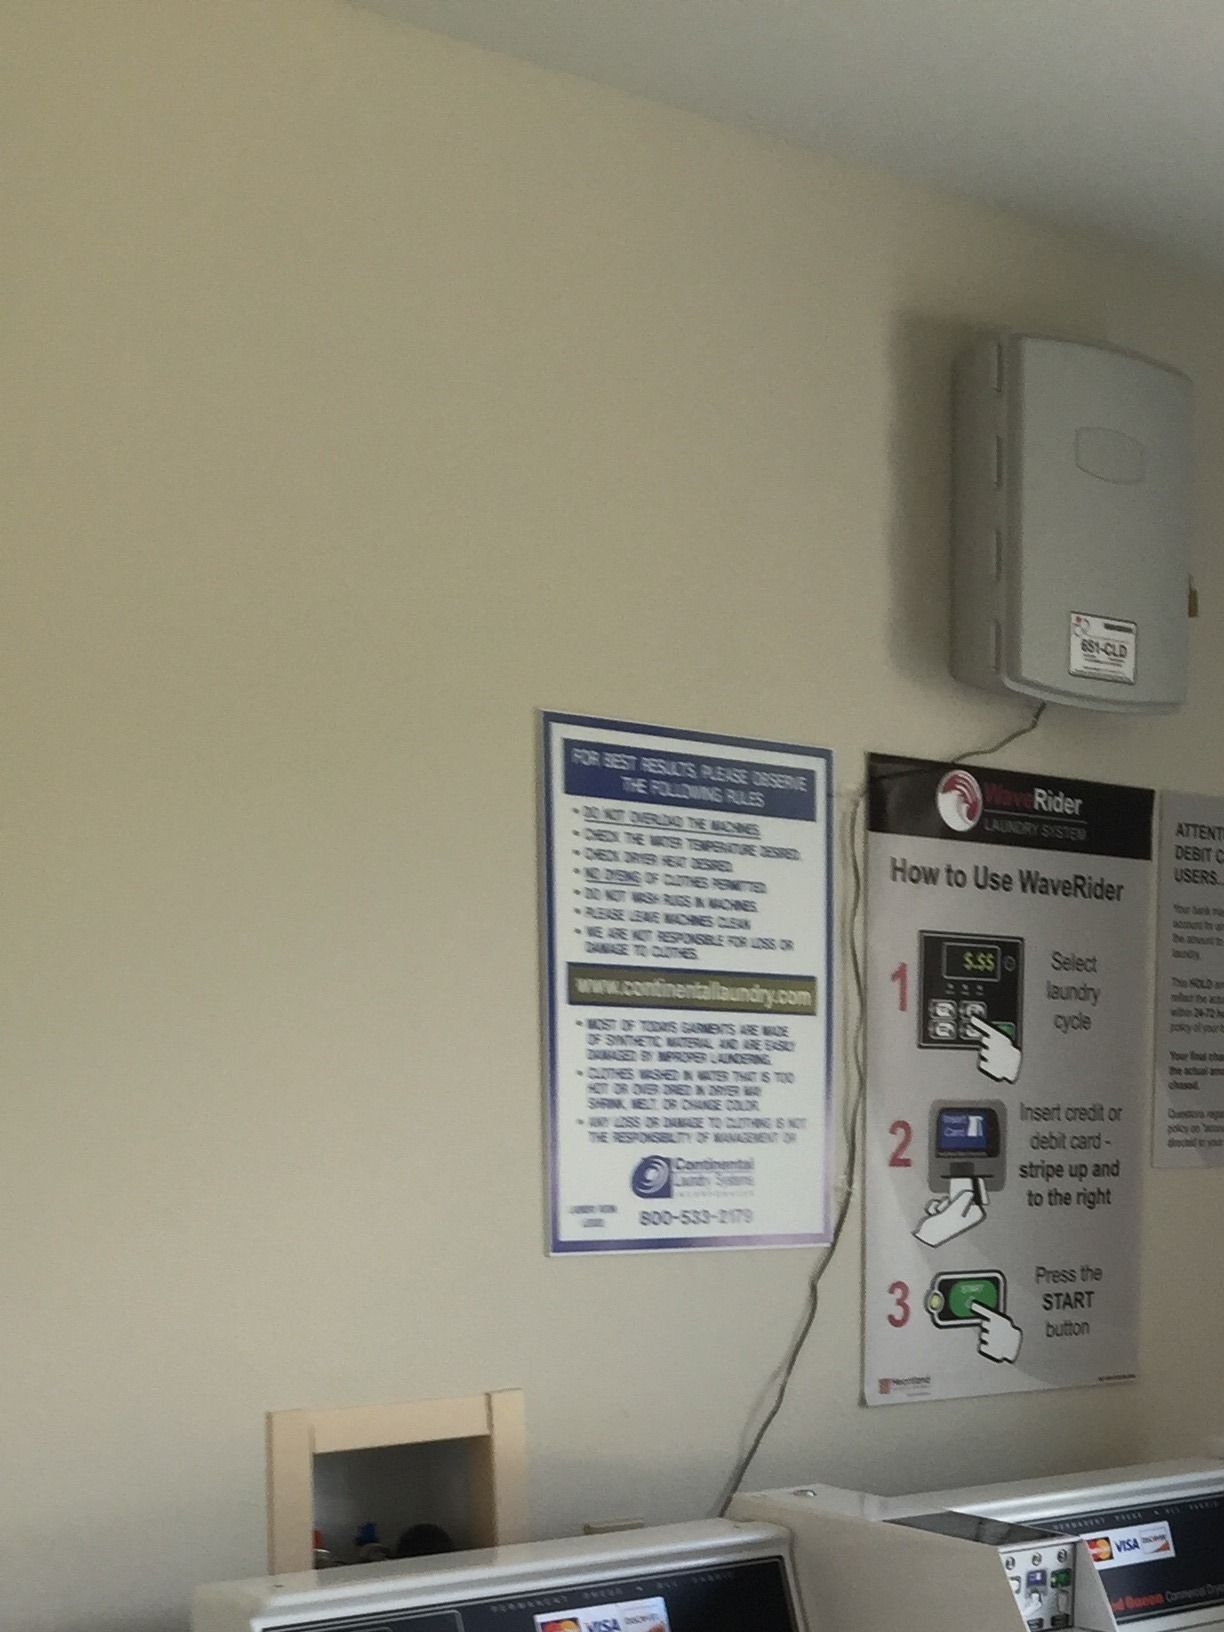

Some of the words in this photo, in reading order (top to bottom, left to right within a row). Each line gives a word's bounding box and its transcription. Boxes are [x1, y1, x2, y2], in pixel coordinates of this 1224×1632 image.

[572, 749, 599, 766] FOR
[604, 753, 636, 771] BEST
[701, 766, 748, 785] PLEASE
[752, 772, 807, 792] OBSERVE
[621, 776, 648, 794] THE
[650, 780, 722, 802] FOLLOWING
[985, 783, 1083, 816] WaveRider
[604, 808, 624, 822] NOT
[688, 817, 706, 830] THE
[984, 819, 1039, 838] LAUNDRY
[1040, 823, 1087, 841] SYSTEM
[584, 828, 619, 842] CHECK
[624, 832, 644, 846] THE
[650, 834, 682, 849] WATER
[686, 838, 757, 857] TEMPERATURE
[584, 848, 619, 862] CHECK
[1174, 845, 1212, 863] DEBIT
[664, 874, 708, 889] CLOTHES
[890, 857, 940, 887] How
[945, 864, 967, 889] to
[974, 865, 1013, 892] Use
[1019, 869, 1124, 901] WaveRider
[606, 890, 626, 902] NOT
[584, 906, 625, 921] PLEASE
[664, 912, 713, 928] MACHINES
[608, 928, 628, 941] ARE
[632, 930, 652, 942] NOT
[657, 930, 724, 948] RESPONSIBLE
[728, 935, 746, 949] FOR
[751, 936, 776, 950] LOSS
[1051, 951, 1098, 974] Select
[575, 976, 812, 1008] www.continentallaundry.com
[890, 962, 908, 1011] 1
[1047, 980, 1100, 1006] laundry
[588, 1019, 616, 1031] MOST
[740, 1024, 758, 1036] ARE
[1054, 1011, 1092, 1034] cycle
[606, 1034, 662, 1048] SYNTHETIC
[744, 1040, 761, 1050] ARE
[658, 1051, 707, 1064] IMPROPER
[588, 1068, 634, 1080] CLOTHES
[697, 1070, 729, 1082] WATER
[733, 1071, 757, 1083] THAT
[682, 1100, 722, 1112] CHANGE
[1020, 1102, 1062, 1122] Insert
[1065, 1103, 1104, 1121] credit
[1108, 1108, 1123, 1121] or
[614, 1116, 640, 1128] LOSS
[588, 1132, 609, 1144] THE
[888, 1120, 912, 1167] 2
[1030, 1132, 1067, 1151] debit
[1070, 1131, 1102, 1150] card
[676, 1157, 754, 1170] Continental
[1019, 1161, 1064, 1181] stripe
[1069, 1163, 1087, 1181] up
[1092, 1160, 1121, 1178] and
[1027, 1190, 1043, 1207] to
[1047, 1188, 1072, 1206] the
[1077, 1187, 1112, 1210] right
[1035, 1266, 1077, 1283] Press
[1081, 1265, 1103, 1282] the
[887, 1280, 910, 1328] 3
[1042, 1291, 1094, 1311] START
[1046, 1318, 1090, 1337] button
[1115, 1538, 1140, 1553] VISA
